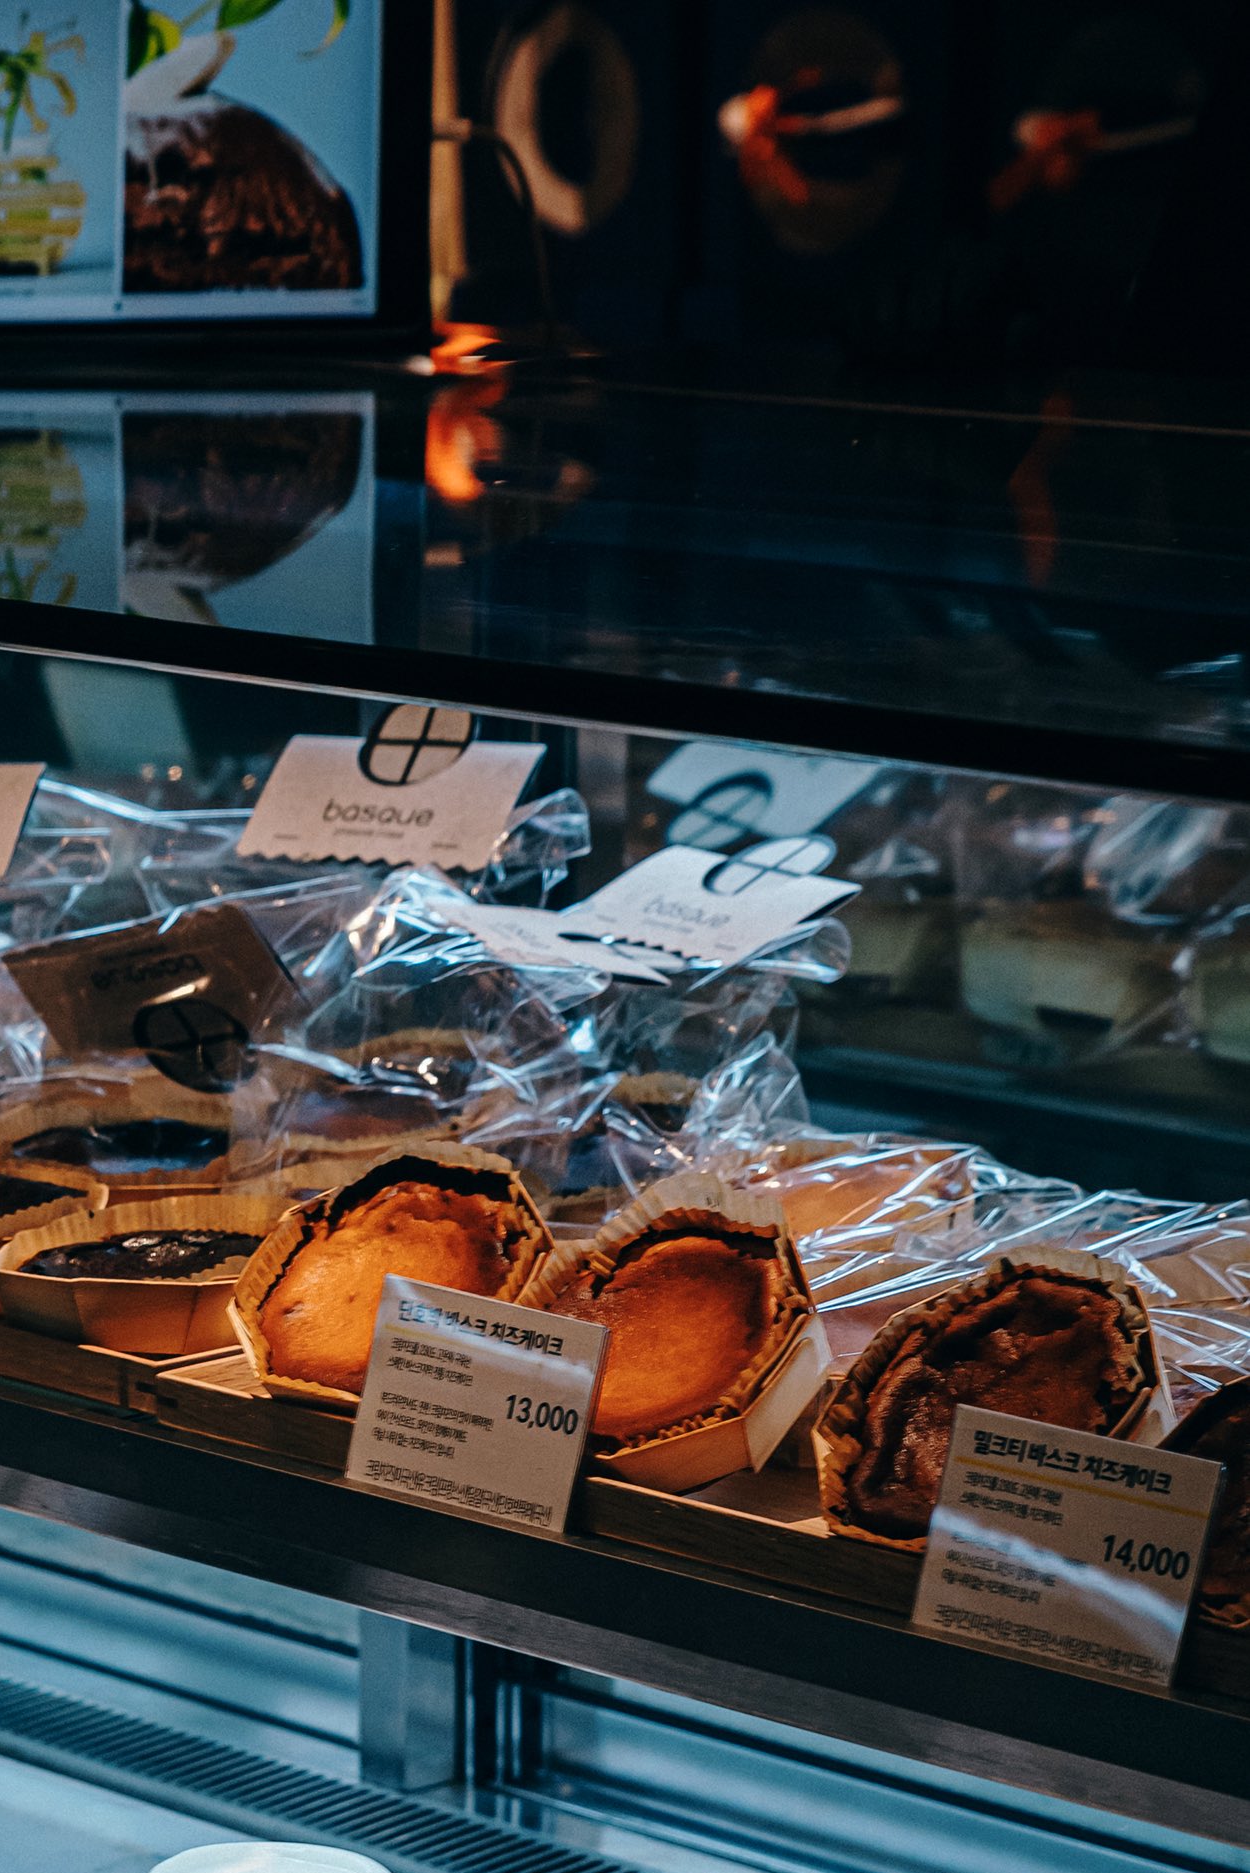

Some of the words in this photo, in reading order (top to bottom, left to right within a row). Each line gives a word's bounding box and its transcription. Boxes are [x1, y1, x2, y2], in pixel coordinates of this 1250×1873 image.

[323, 798, 434, 827] basque
[445, 1311, 488, 1337] 바스크
[490, 1321, 563, 1356] 치즈케이크
[506, 1394, 578, 1435] 13,000
[974, 1430, 1027, 1462] 밀크티
[1028, 1442, 1079, 1473] 바스크
[1083, 1456, 1172, 1495] 치즈케이크
[1103, 1534, 1190, 1580] 14,000
